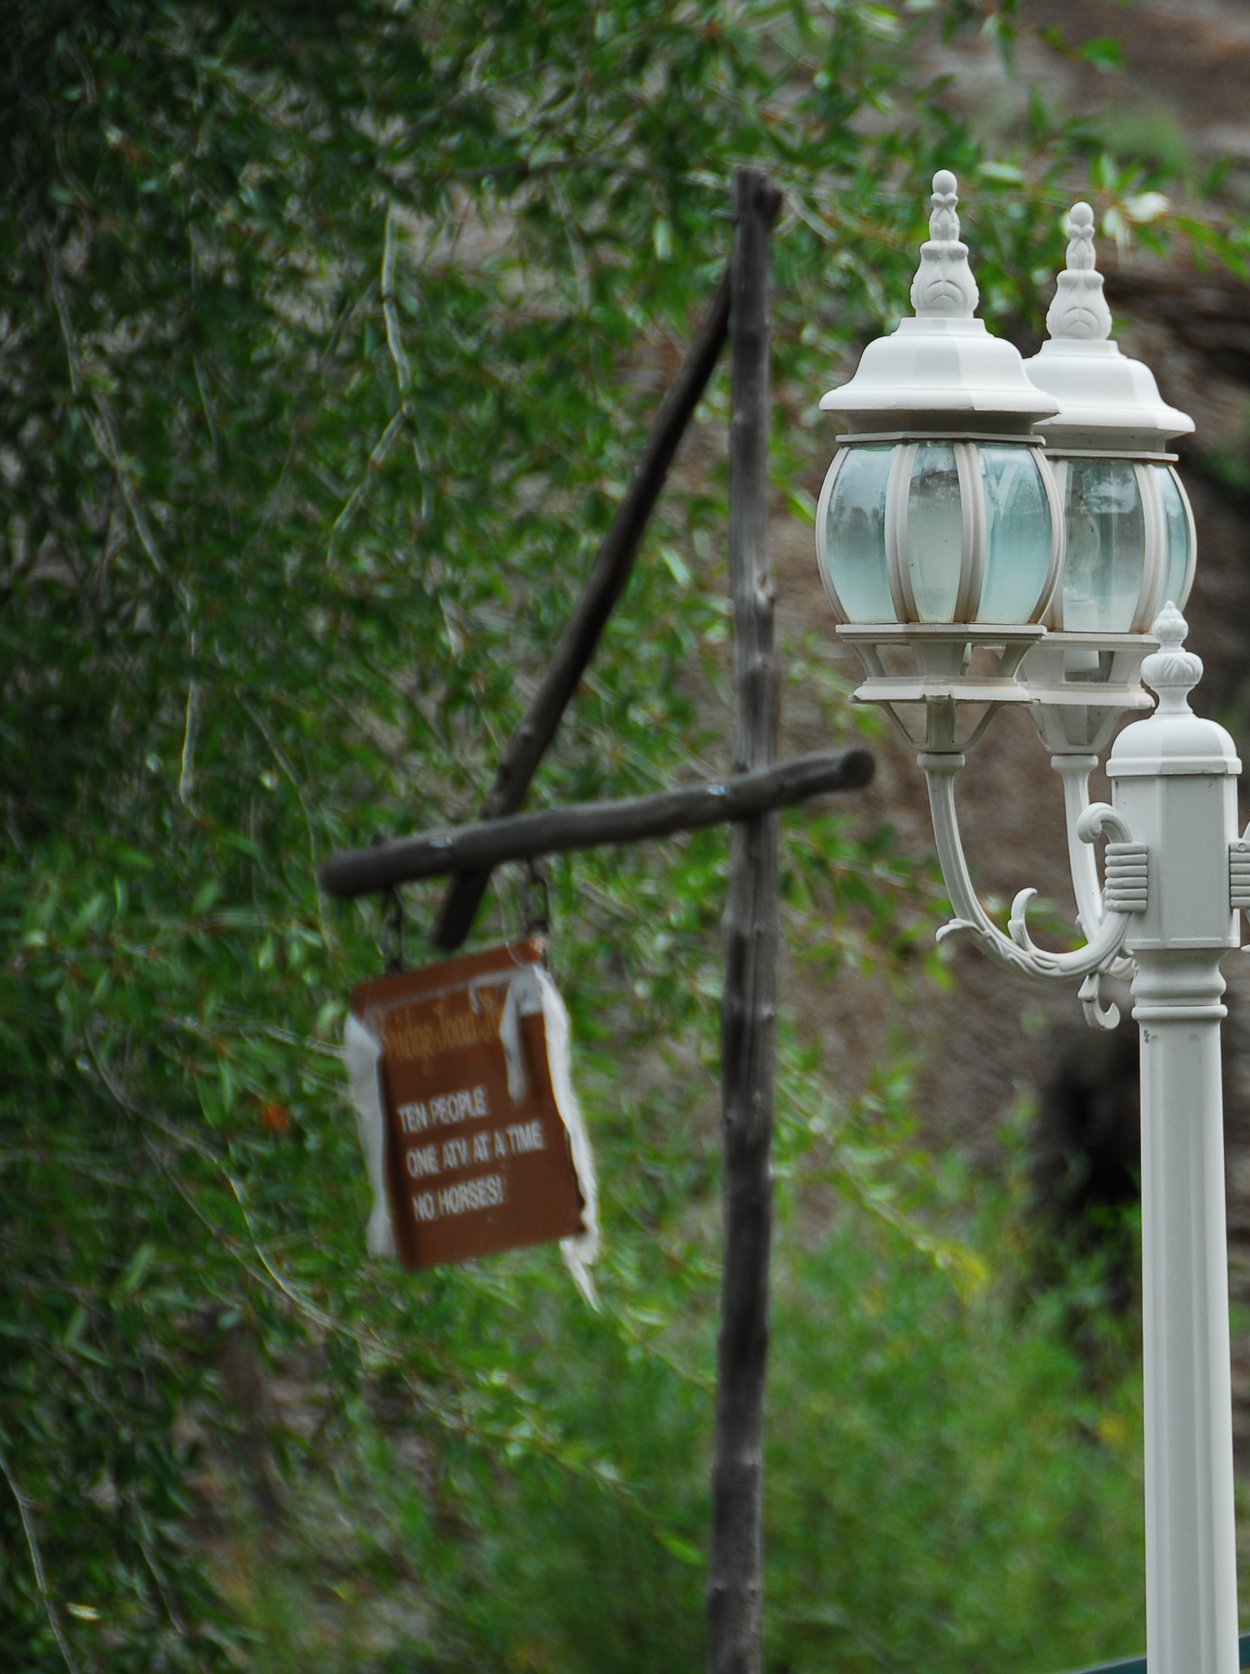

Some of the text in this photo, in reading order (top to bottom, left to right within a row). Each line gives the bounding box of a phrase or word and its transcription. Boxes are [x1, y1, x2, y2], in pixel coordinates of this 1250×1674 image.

[398, 1085, 488, 1133] TEN PEOPLE
[406, 1119, 546, 1179] ONE ATV AT A TIME
[412, 1175, 504, 1221] NO HORSES!
